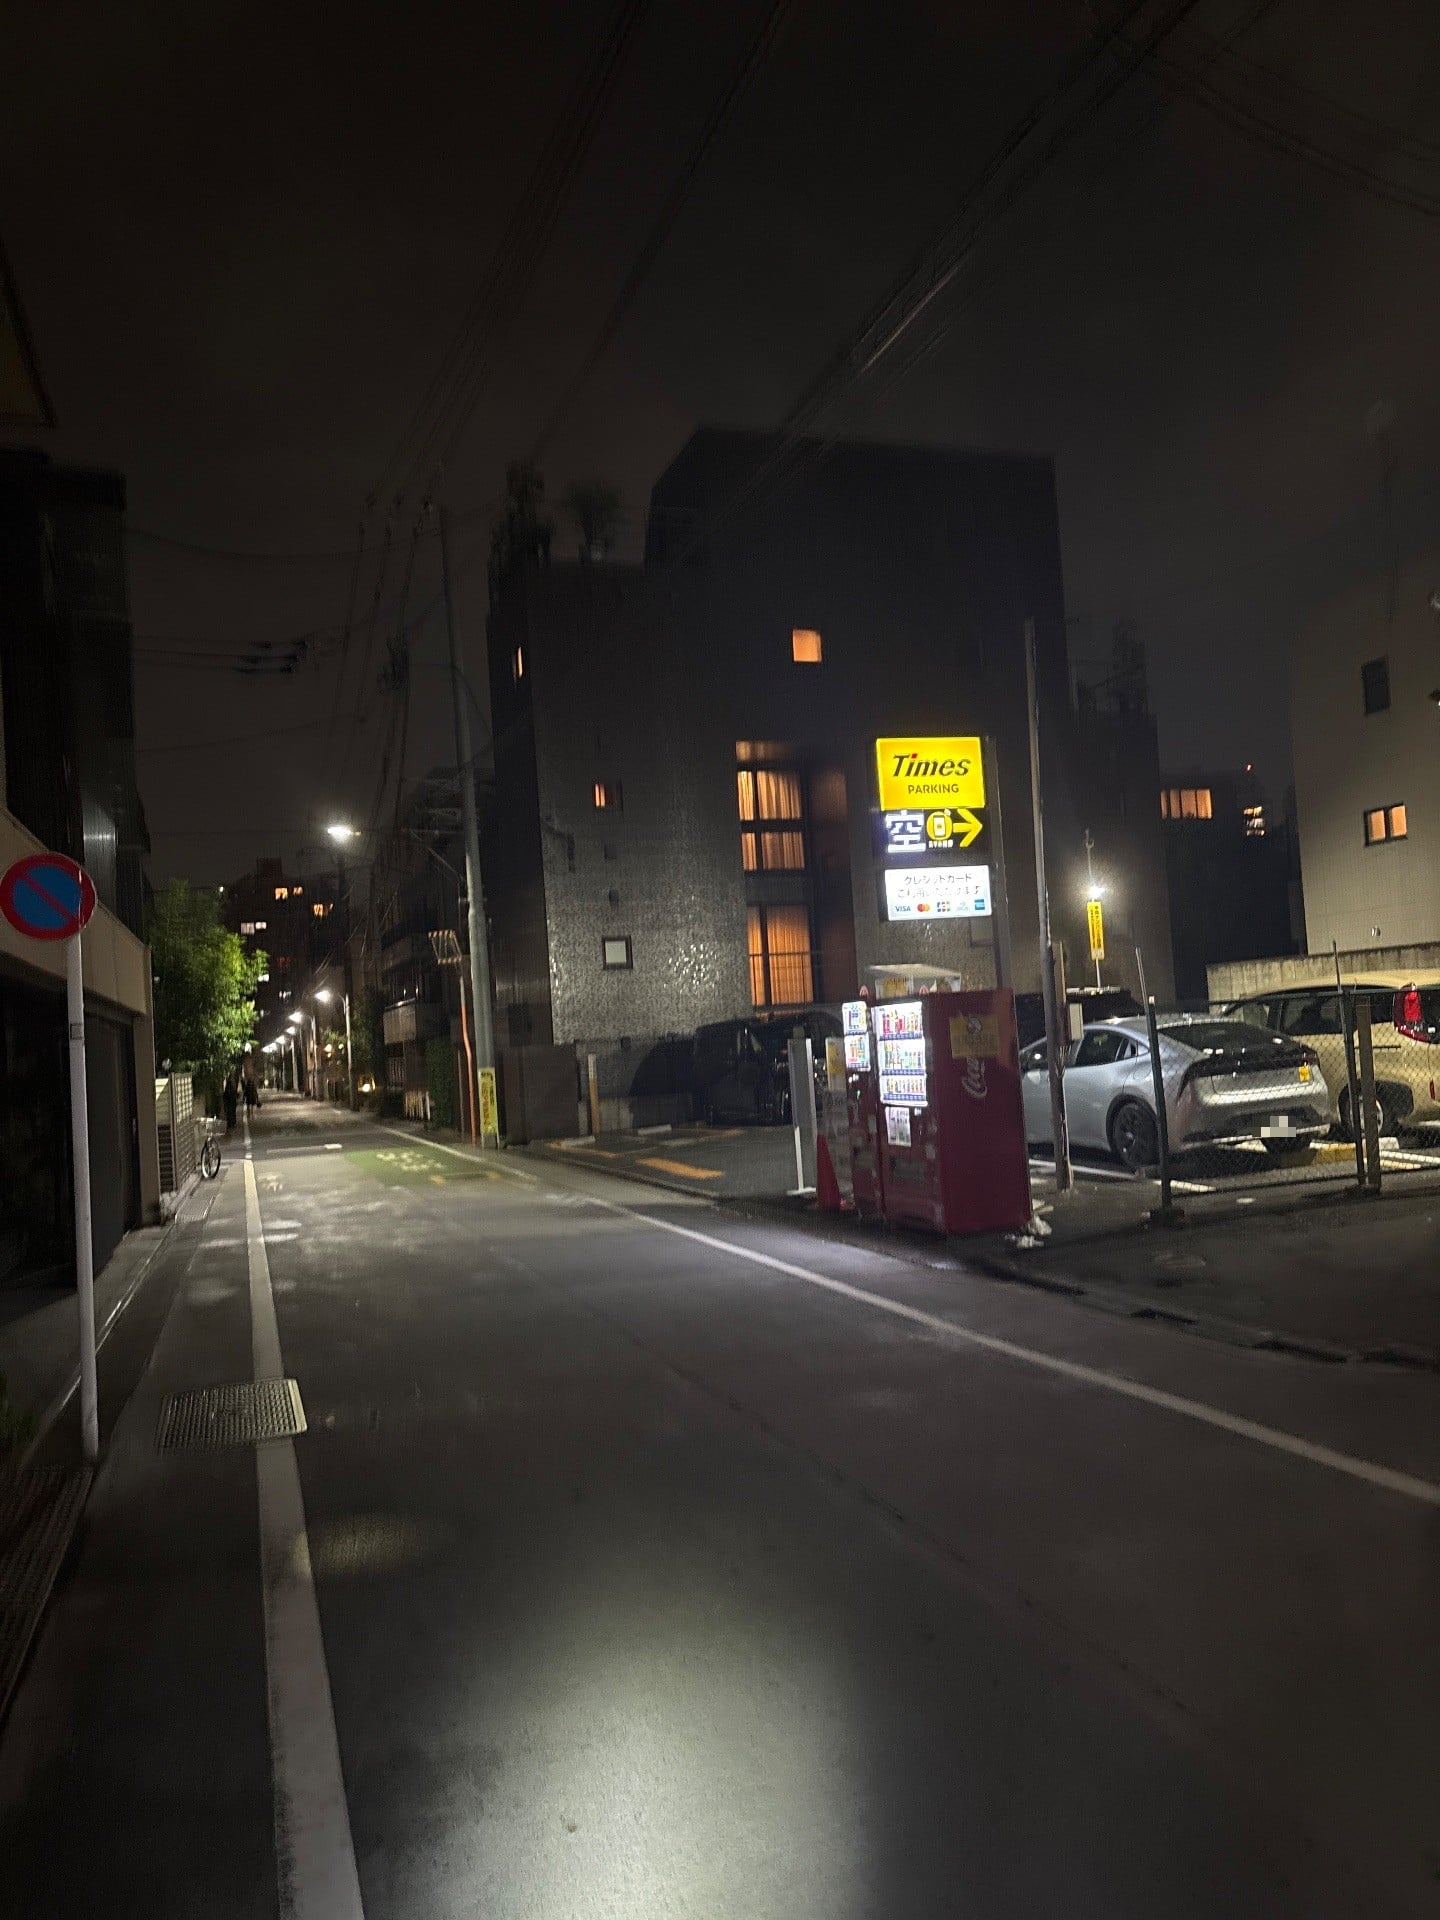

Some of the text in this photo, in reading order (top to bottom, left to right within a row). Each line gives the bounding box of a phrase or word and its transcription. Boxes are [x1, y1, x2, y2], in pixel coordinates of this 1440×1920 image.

[892, 753, 971, 777] Times
[908, 783, 959, 794] PARKING
[885, 809, 926, 853] 空
